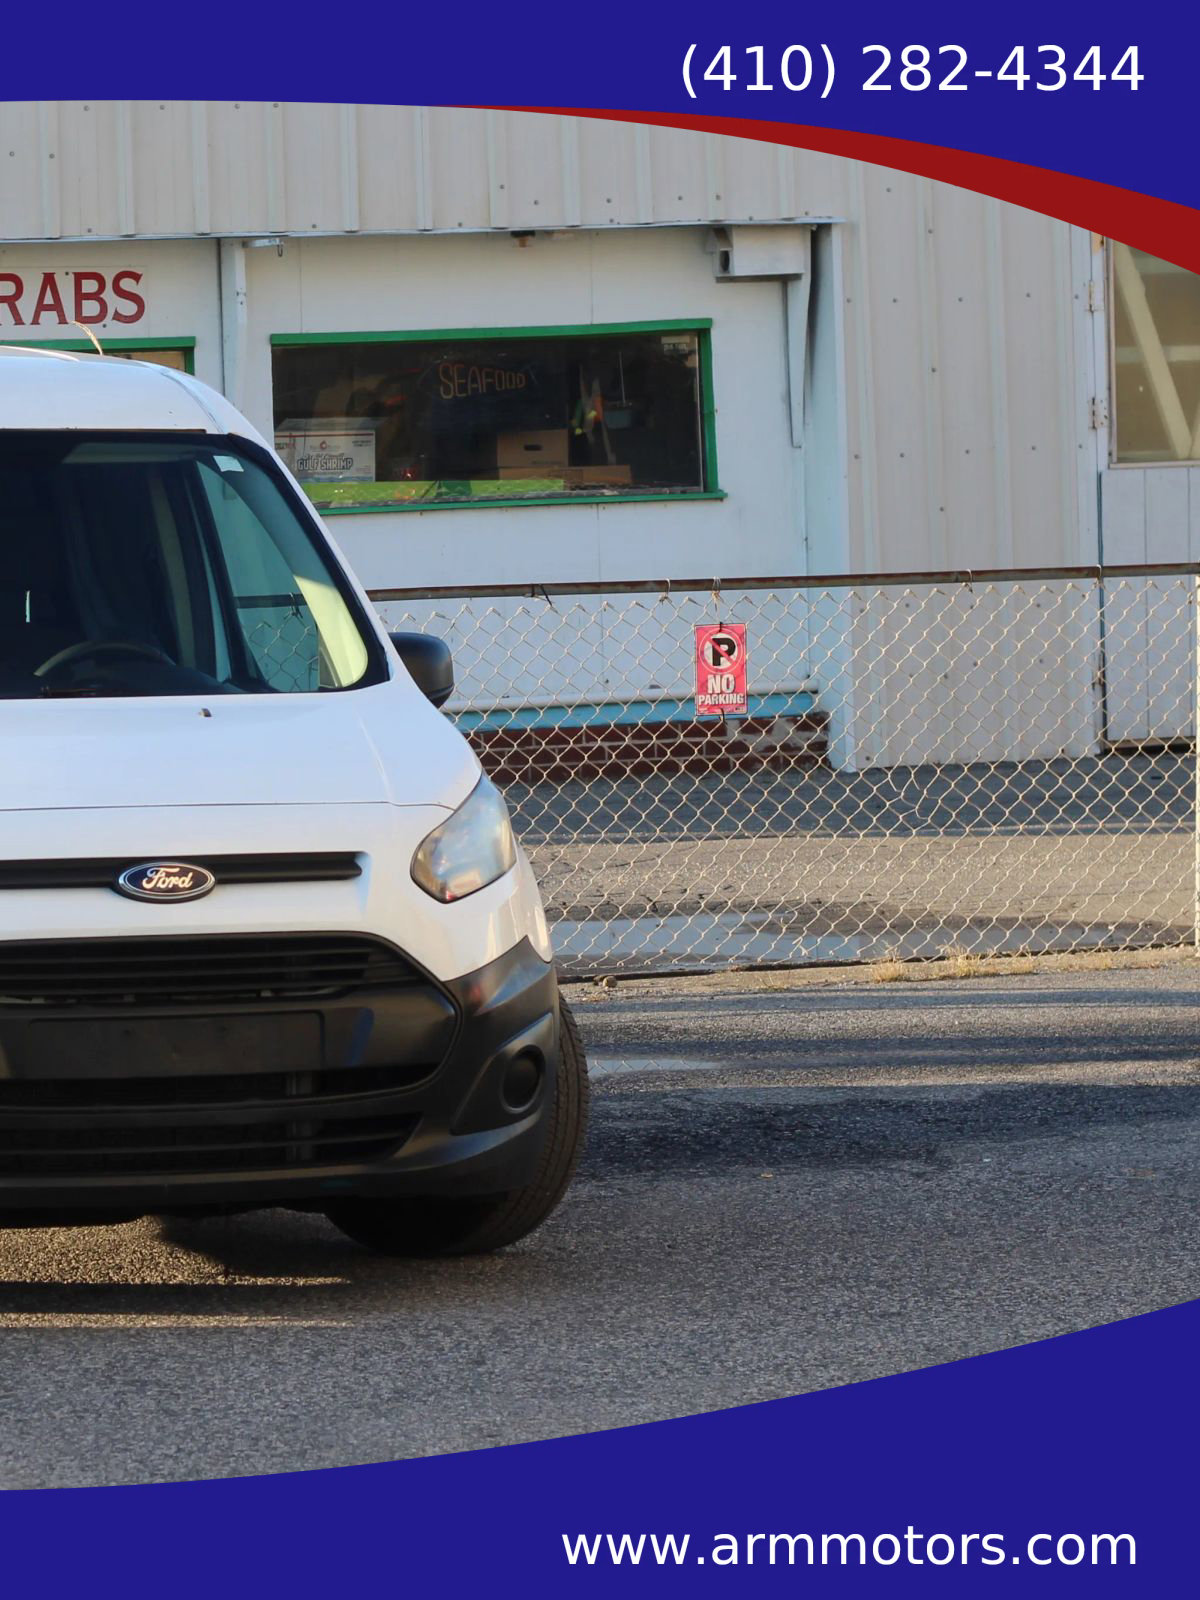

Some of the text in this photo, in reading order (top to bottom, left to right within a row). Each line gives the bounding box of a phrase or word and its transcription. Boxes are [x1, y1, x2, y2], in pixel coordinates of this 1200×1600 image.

[439, 362, 527, 400] SEAFOOD
[296, 458, 320, 473] GULF
[319, 457, 354, 472] SHRIMP
[707, 673, 736, 694] NO
[698, 693, 744, 706] PARKING
[141, 867, 193, 889] Ford
